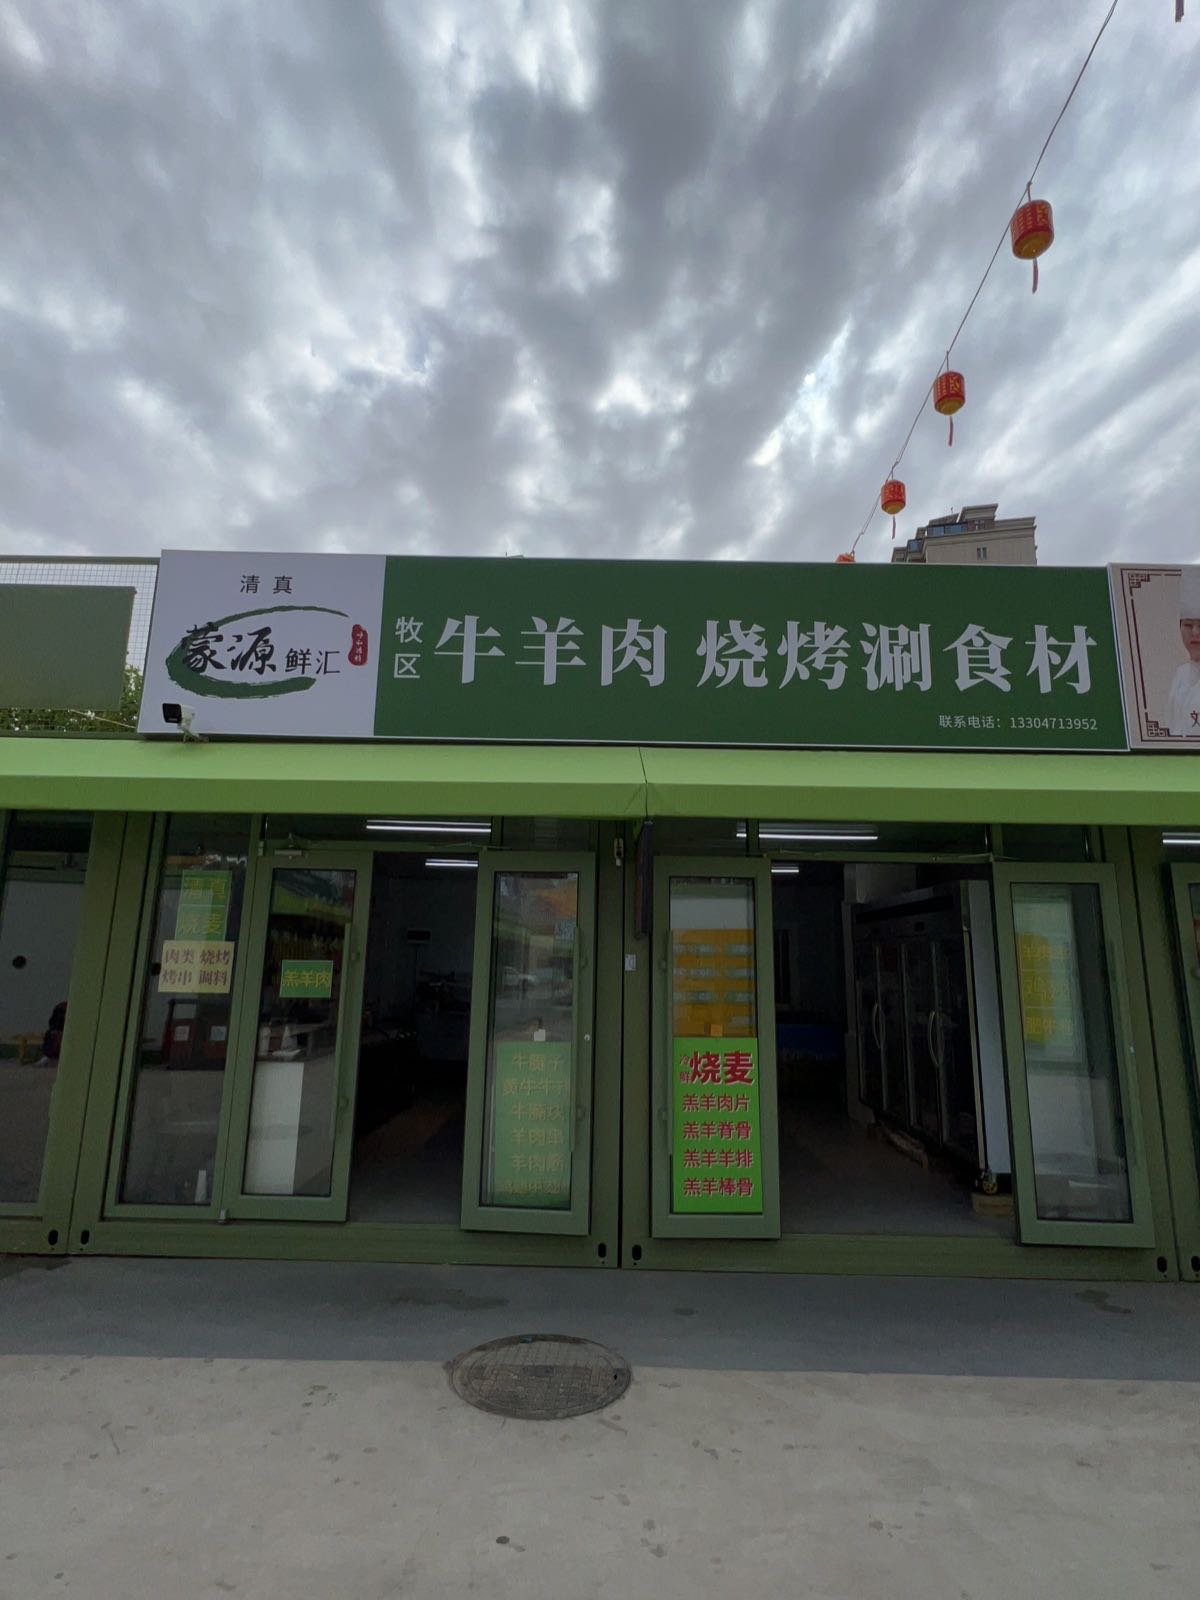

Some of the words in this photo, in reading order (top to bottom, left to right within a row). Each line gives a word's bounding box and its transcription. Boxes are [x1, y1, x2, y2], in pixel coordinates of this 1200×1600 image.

[240, 575, 293, 594] 清真
[282, 969, 330, 987] 羔羊肉
[689, 1050, 754, 1085] 烧麦
[682, 1092, 750, 1112] 羔羊肉片
[683, 1120, 752, 1141] 羔羊脊骨
[683, 1148, 753, 1169] 羔羊羊排
[683, 1177, 753, 1197] 羔羊棒骨
